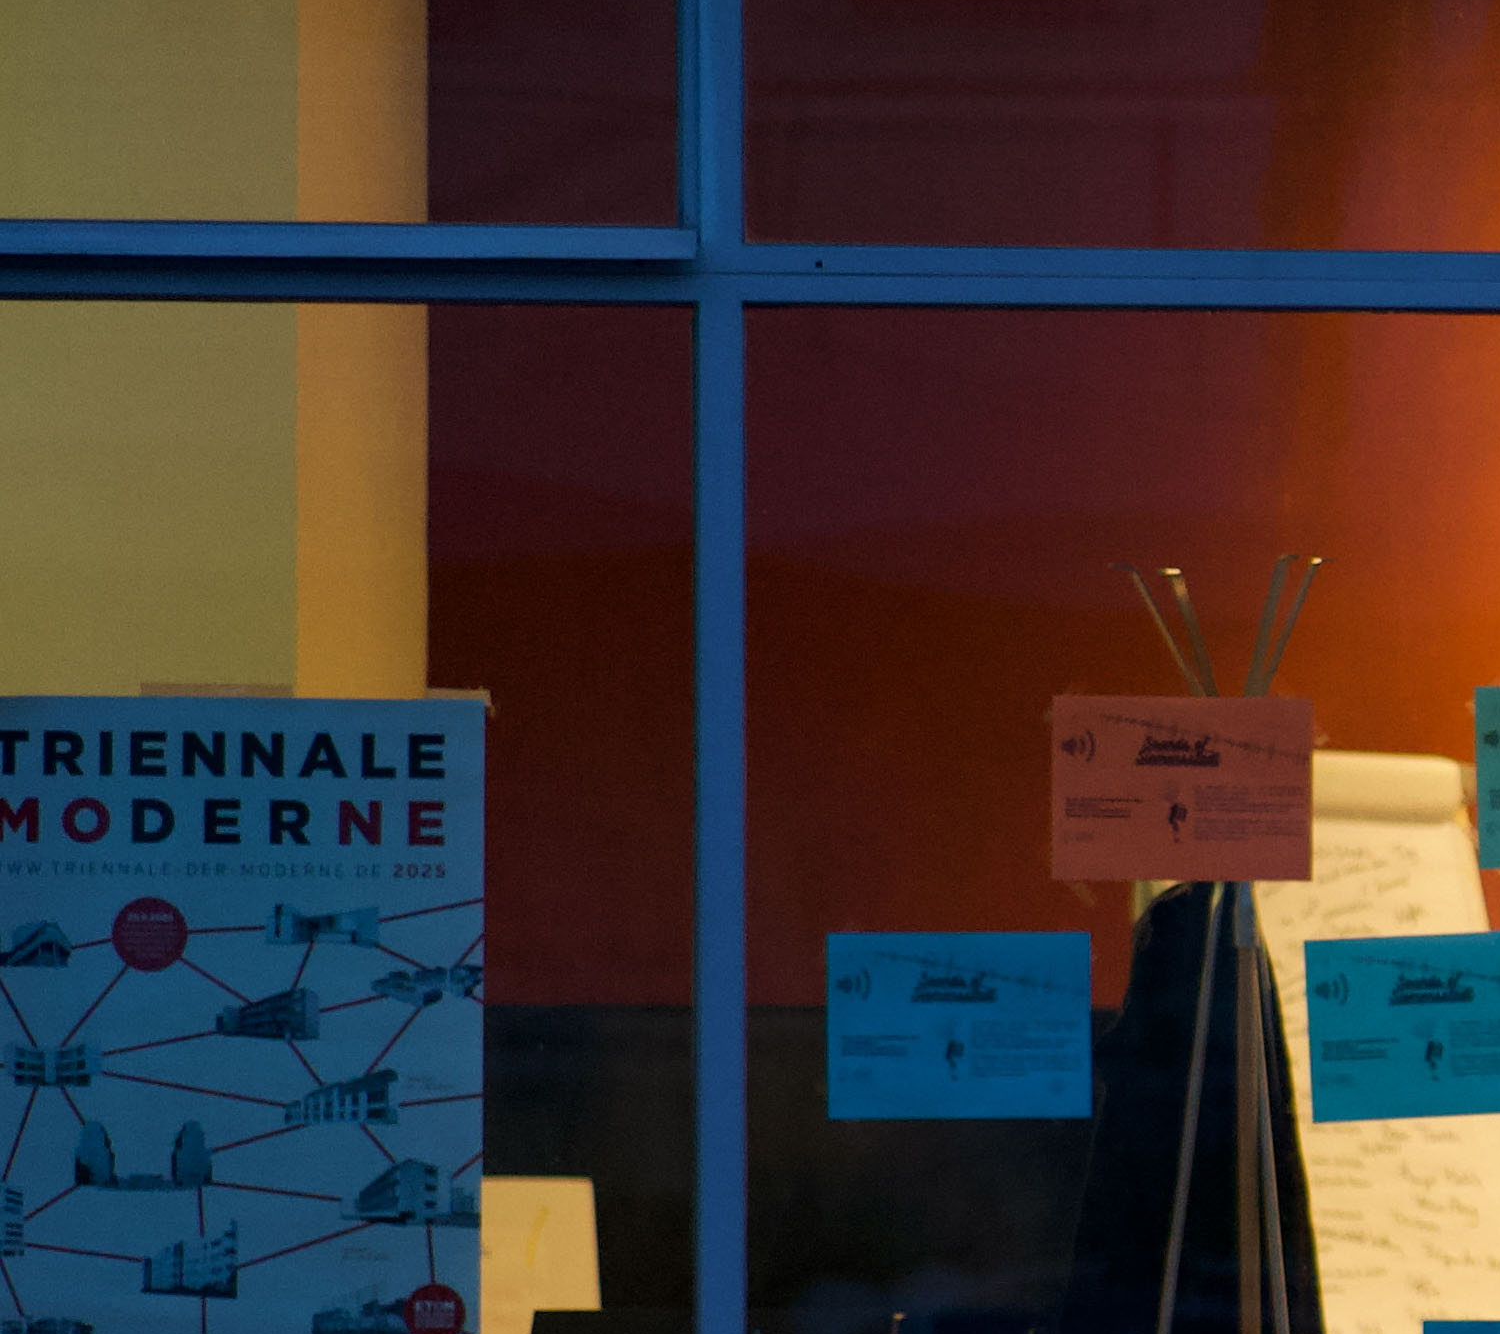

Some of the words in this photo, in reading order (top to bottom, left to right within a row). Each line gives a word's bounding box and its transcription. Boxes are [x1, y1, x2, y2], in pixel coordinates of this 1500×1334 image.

[0, 730, 446, 778] TRIENNALE
[0, 797, 446, 846] MODERNE
[392, 863, 446, 880] 2025
